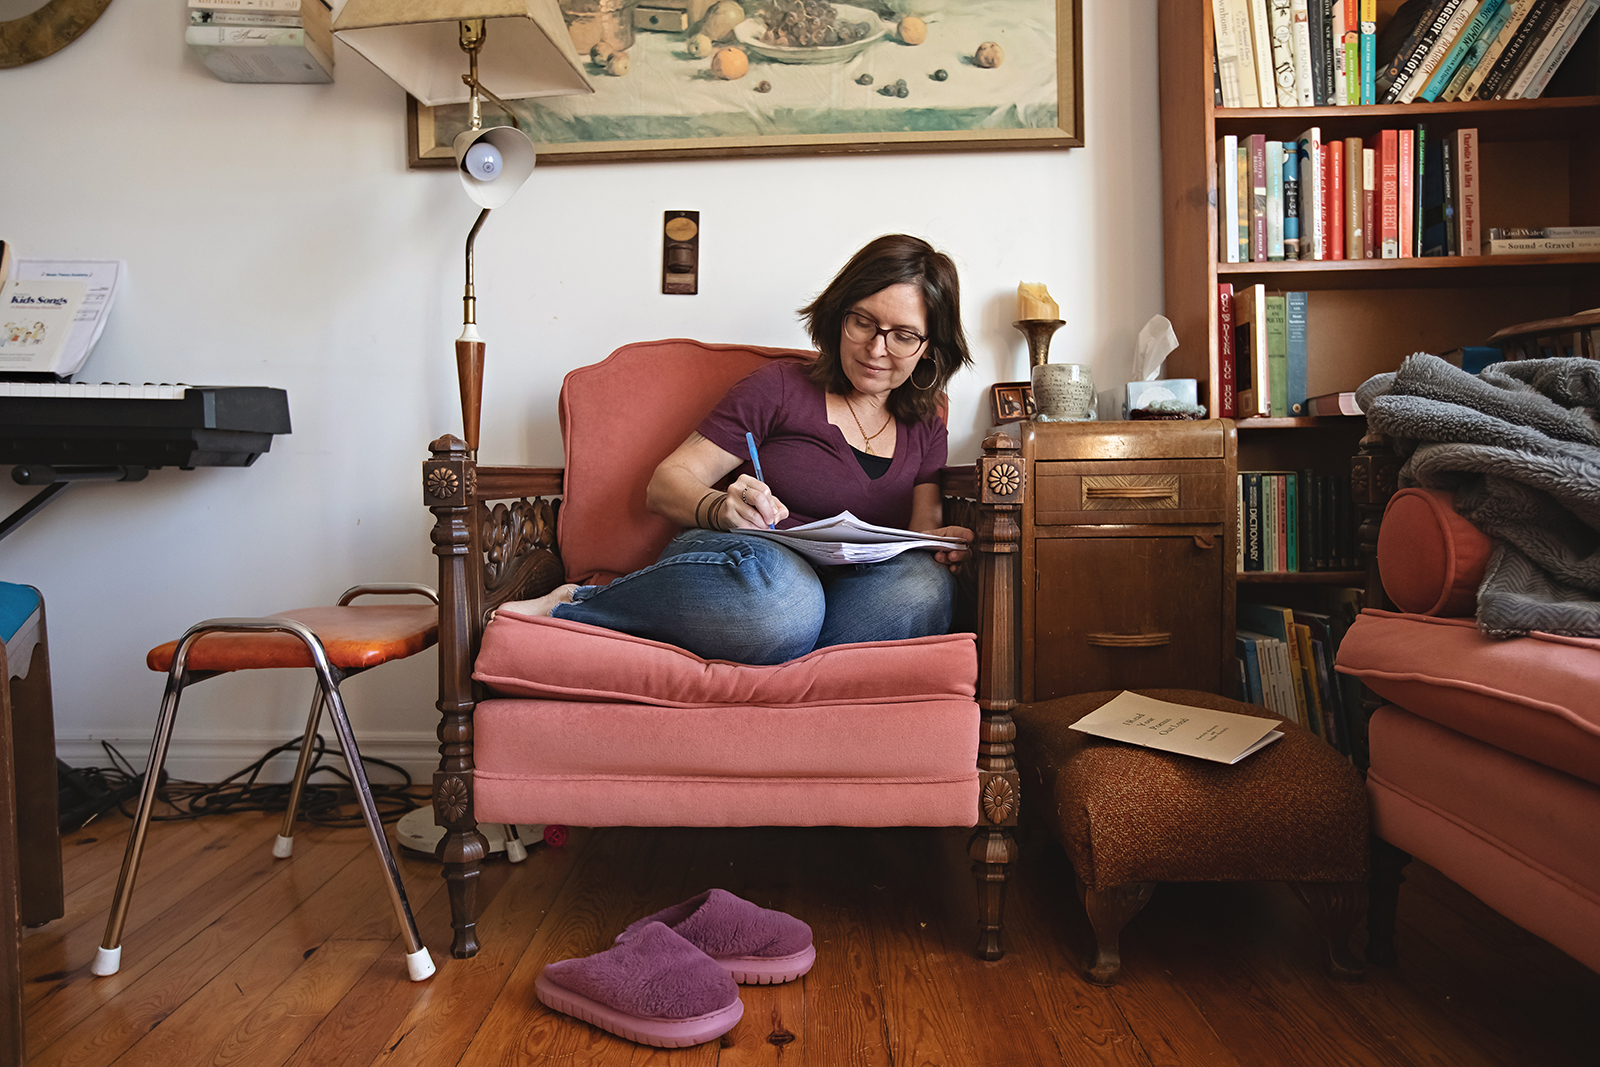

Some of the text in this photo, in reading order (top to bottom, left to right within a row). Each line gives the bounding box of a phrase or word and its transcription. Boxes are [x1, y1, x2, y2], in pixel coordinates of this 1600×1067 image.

[1428, 0, 1461, 35] PAGEBOY
[1479, 0, 1500, 21] BEING
[1522, 9, 1542, 34] ESSEX
[1541, 7, 1561, 32] POITIER
[1458, 18, 1485, 48] HUMAN
[1531, 36, 1541, 47] THE
[1298, 24, 1308, 80] ALICE MUNRO
[1403, 43, 1429, 74] ELLIOT
[1498, 33, 1528, 69] SERPENT
[1517, 46, 1535, 68] MEASURE
[1485, 70, 1499, 87] PERRY
[1512, 67, 1520, 76] OF
[1388, 72, 1409, 96] PAGE
[1502, 79, 1513, 92] MAN
[1464, 160, 1472, 172] Vale
[1464, 174, 1472, 188] Allen
[1384, 164, 1396, 230] THE ROSIE EFFECT
[1465, 194, 1474, 218] Leftover
[1466, 220, 1474, 242] Dreams
[37, 296, 68, 306] Songs
[1222, 324, 1230, 355] DIVER
[1250, 508, 1258, 561] DICTIONARY
